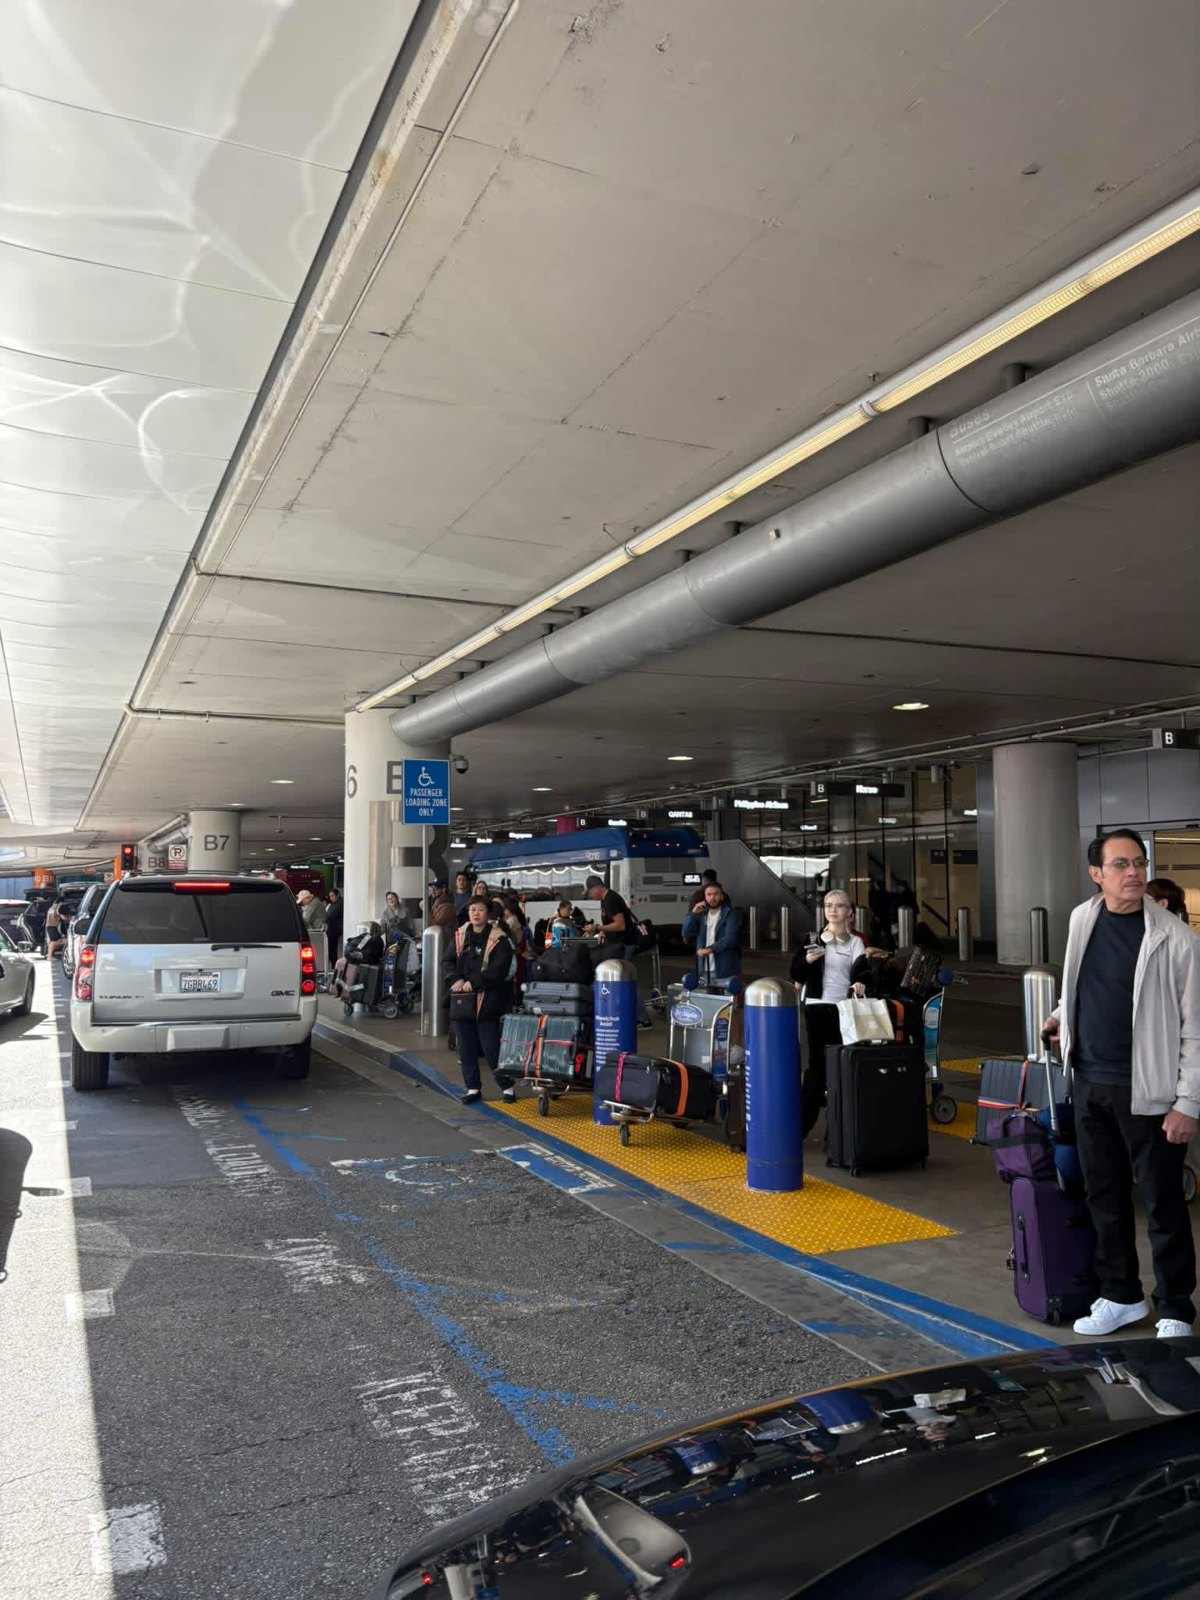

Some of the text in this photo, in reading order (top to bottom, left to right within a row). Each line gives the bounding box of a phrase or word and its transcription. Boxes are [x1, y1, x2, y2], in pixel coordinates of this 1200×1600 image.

[1165, 731, 1173, 744] B
[346, 764, 358, 799] 6
[409, 788, 443, 797] PASSENGER
[818, 784, 825, 793] B
[405, 798, 448, 807] LOADING ZONE
[418, 807, 435, 817] ONLY
[668, 810, 693, 819] QANTAS
[580, 818, 586, 826] B
[204, 835, 230, 851] B7
[148, 857, 165, 868] B8
[183, 979, 217, 990] 7GBR469
